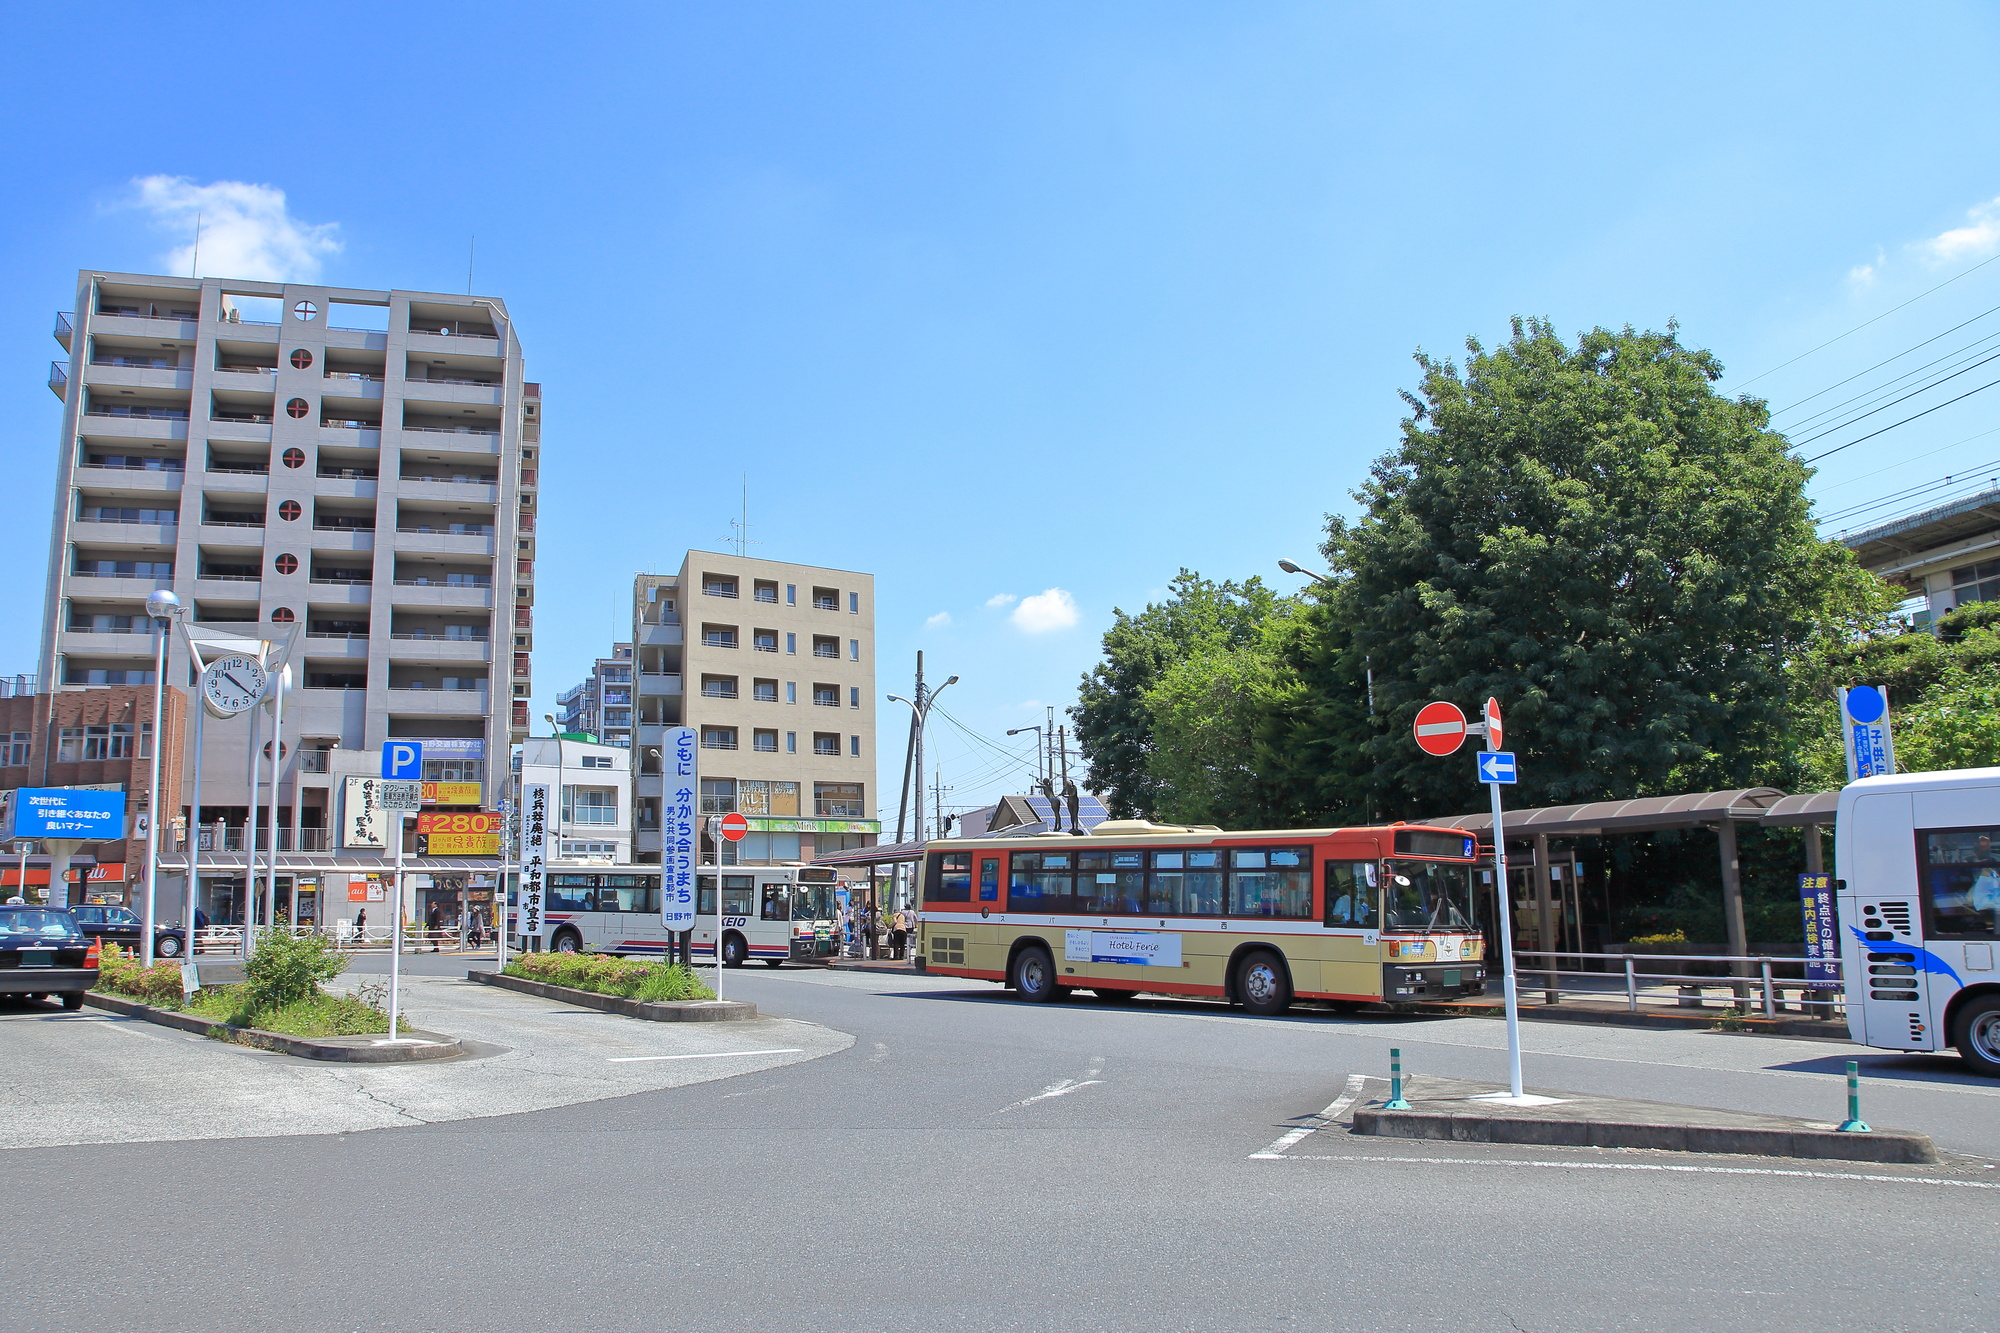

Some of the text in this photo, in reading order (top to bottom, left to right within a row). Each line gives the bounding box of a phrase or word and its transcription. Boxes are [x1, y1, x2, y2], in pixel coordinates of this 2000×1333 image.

[223, 662, 231, 670] 11
[233, 659, 242, 668] 12
[246, 662, 250, 670] 1
[214, 670, 224, 678] 10
[252, 669, 258, 677] 2
[212, 680, 218, 688] 9
[215, 690, 220, 698] 8
[223, 696, 229, 704] 7
[232, 699, 238, 707] 6
[242, 696, 248, 704] 5
[392, 746, 415, 776] P
[29, 796, 68, 806] 次世代に
[38, 808, 111, 820] 引き継ぐあなたの
[676, 731, 693, 903] ともに 分かち合うまち
[46, 822, 94, 830] 良いマナー
[796, 822, 817, 830] Mink
[666, 806, 676, 902] 男女共同参画宣言都市
[526, 788, 545, 932] 核兵器廃絶・平和都市宣言
[1802, 876, 1828, 888] 注意
[666, 912, 692, 921] 日野市
[722, 917, 746, 926] KEIO
[1110, 940, 1159, 951] Hotel Ferie
